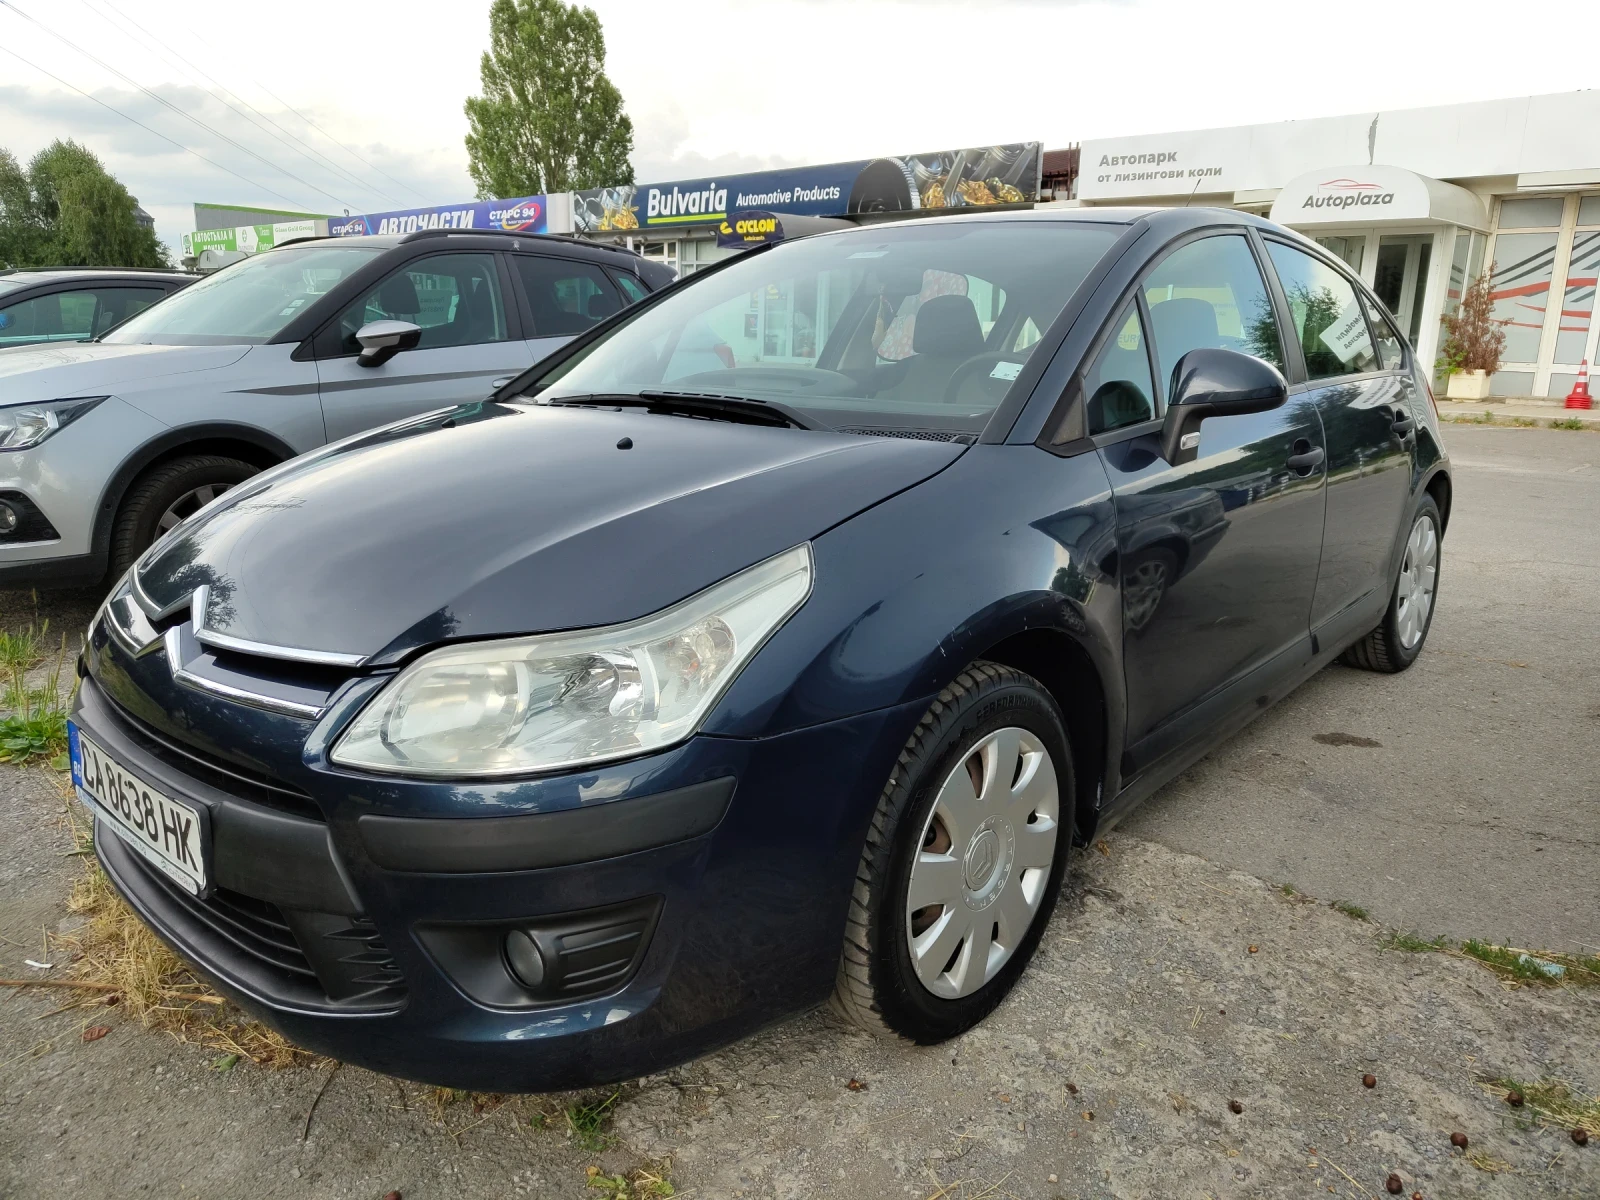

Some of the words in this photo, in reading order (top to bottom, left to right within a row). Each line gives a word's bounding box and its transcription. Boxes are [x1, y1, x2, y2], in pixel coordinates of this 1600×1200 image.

[1099, 151, 1177, 167] Автопарк
[1097, 173, 1112, 183] от
[1114, 169, 1184, 183] лизингови
[1188, 166, 1222, 177] коли
[647, 182, 727, 216] Bulvaria
[736, 189, 791, 207] Automotive
[793, 185, 840, 202] Products
[1302, 191, 1394, 210] Autoplaza
[378, 210, 474, 235] АВТОЧАСТИ
[489, 209, 520, 220] СТАРС
[522, 207, 534, 217] 94
[332, 225, 353, 234] СТАРС
[354, 224, 363, 232] 94
[736, 219, 776, 234] CYCLON
[74, 760, 82, 778] BG
[81, 739, 107, 800] CA
[105, 761, 159, 843] 8638
[159, 800, 198, 873] HK
